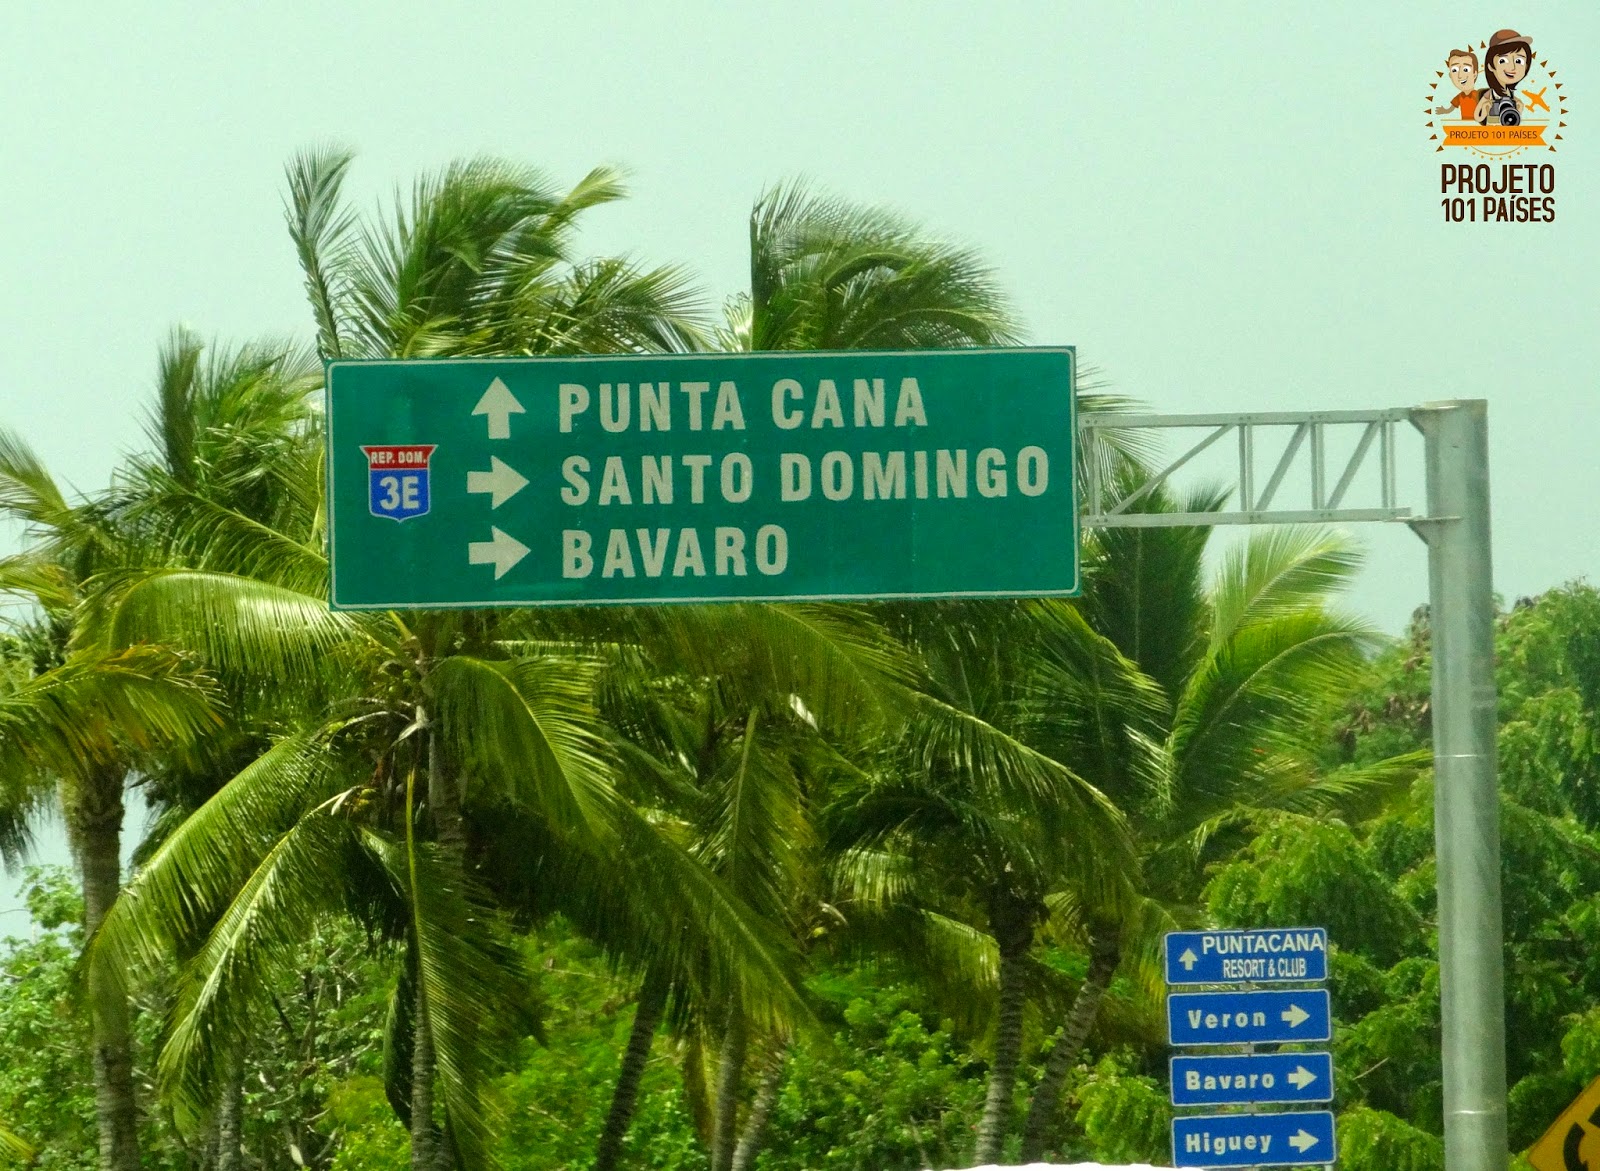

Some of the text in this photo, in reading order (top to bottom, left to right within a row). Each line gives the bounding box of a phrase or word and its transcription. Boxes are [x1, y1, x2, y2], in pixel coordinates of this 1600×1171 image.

[558, 377, 928, 433] PUNTA CANA
[370, 450, 427, 464] REP. DOM.
[560, 445, 1049, 506] SANTO DOMINGO
[380, 476, 420, 510] 3E
[562, 524, 789, 579] BAVARO
[1202, 932, 1325, 955] PUNTACANA
[1223, 957, 1307, 979] RESORT & CLUB
[1187, 1009, 1266, 1029] Veron
[1185, 1070, 1275, 1091] Bavaro
[1185, 1131, 1272, 1155] Higuey
